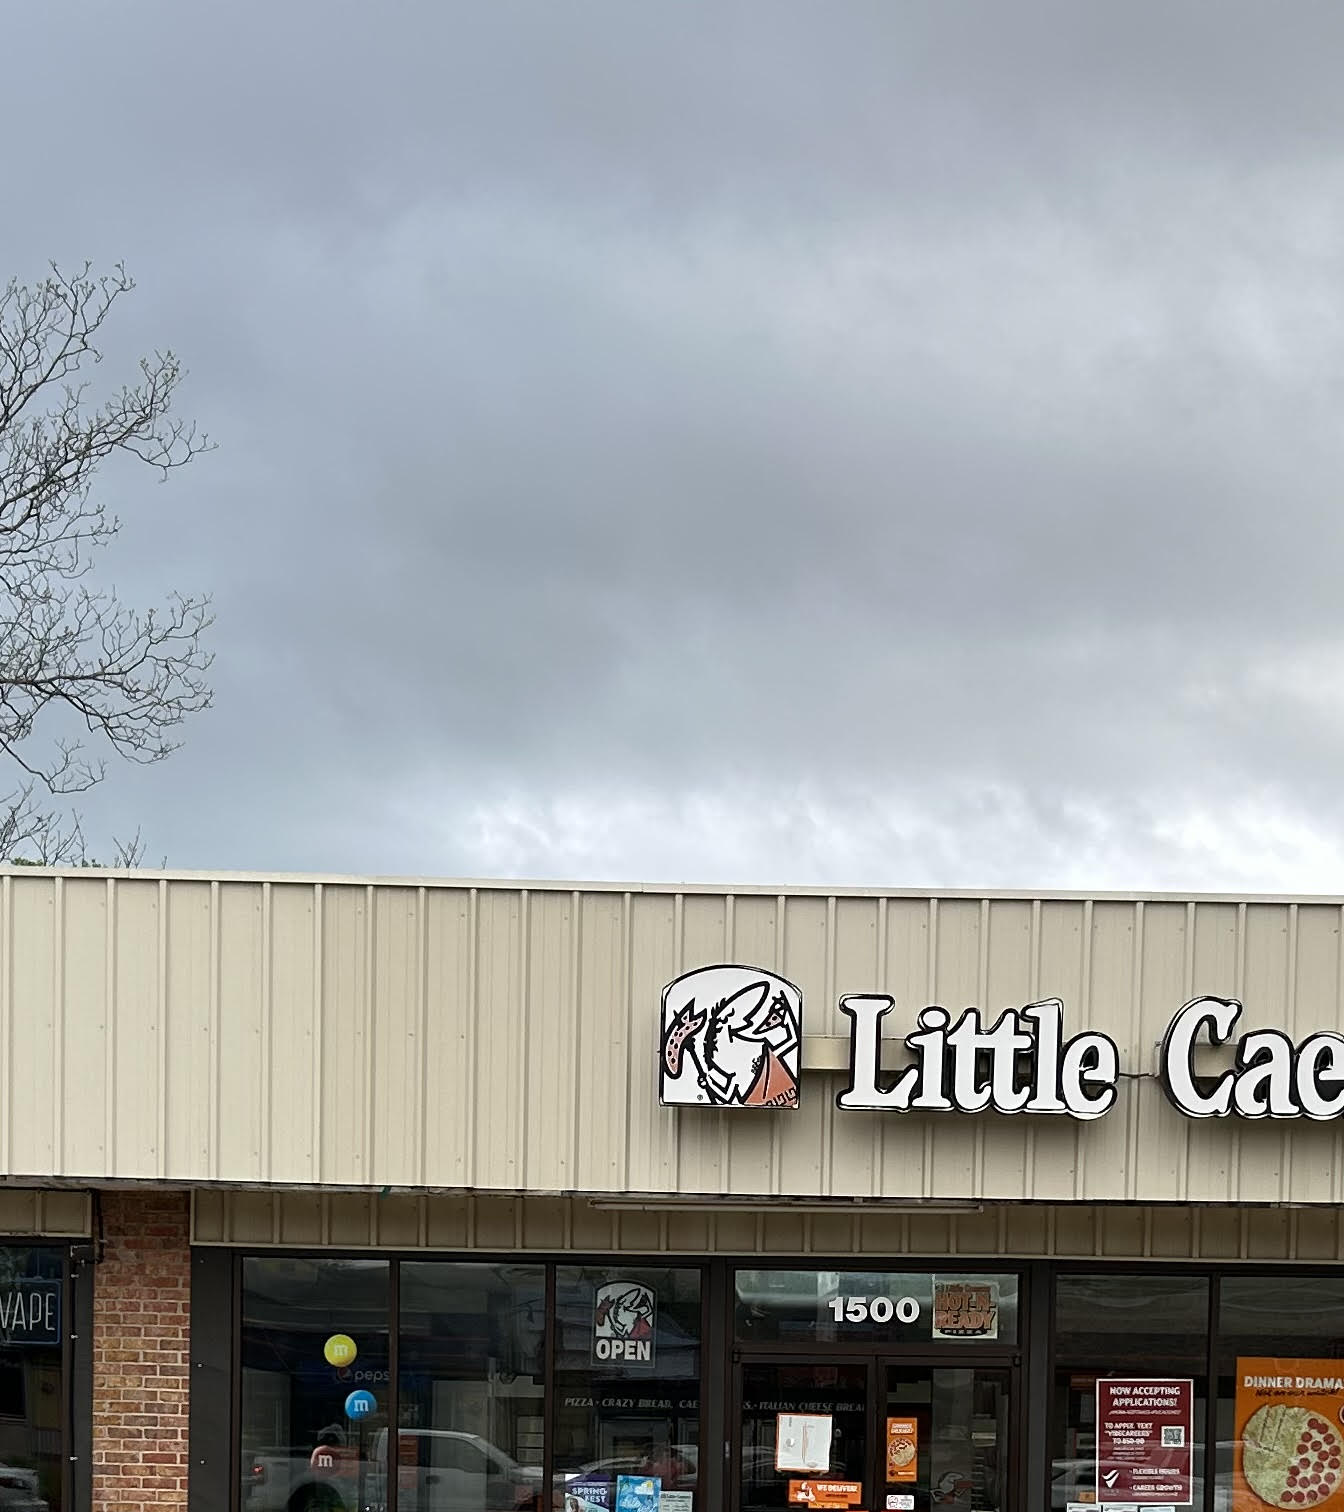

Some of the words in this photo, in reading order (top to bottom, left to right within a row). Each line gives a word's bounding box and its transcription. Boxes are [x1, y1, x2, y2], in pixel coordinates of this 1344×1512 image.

[837, 994, 1120, 1121] Little
[828, 1296, 920, 1324] 1500
[935, 1310, 996, 1330] READY
[333, 1344, 348, 1356] m
[595, 1338, 651, 1361] OPEN
[354, 1370, 391, 1383] peps
[1243, 1375, 1293, 1388] DINNER
[1109, 1386, 1131, 1395] NOW
[1132, 1386, 1180, 1395] ACCEPTING
[353, 1400, 369, 1412] m
[564, 1398, 594, 1407] PIZZA
[601, 1398, 634, 1408] CRAZY
[318, 1454, 333, 1467] m
